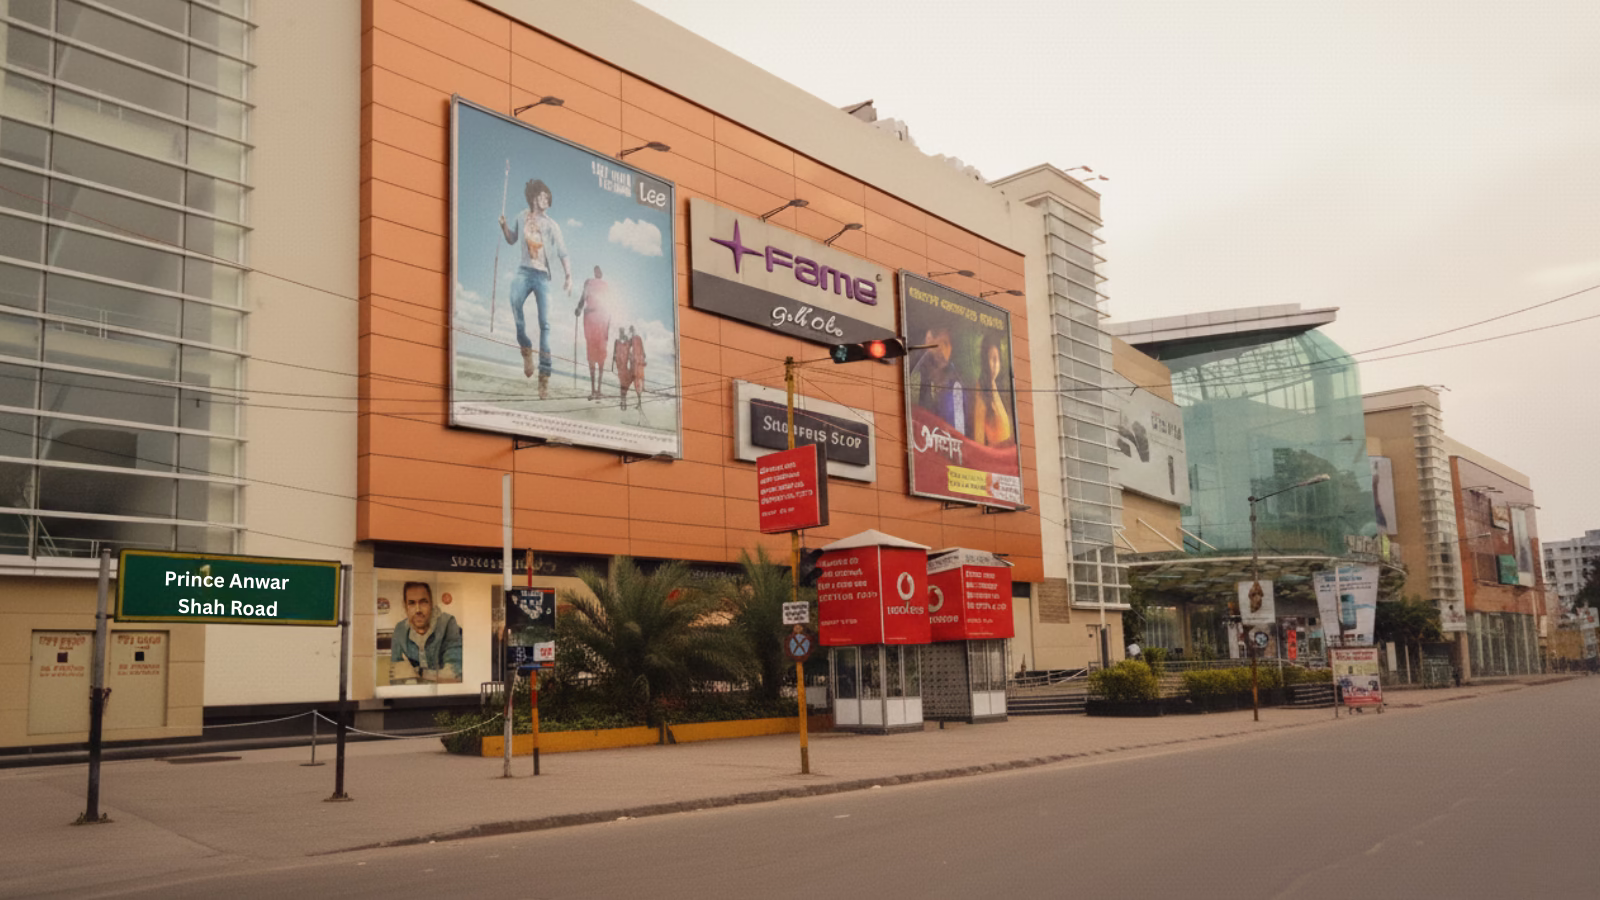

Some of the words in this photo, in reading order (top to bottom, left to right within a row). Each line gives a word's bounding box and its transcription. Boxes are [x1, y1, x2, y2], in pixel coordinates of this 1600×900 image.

[639, 182, 666, 207] Lee
[165, 571, 225, 588] Prince
[229, 573, 290, 590] Anwar
[178, 598, 225, 615] Shah
[231, 600, 278, 617] Road
